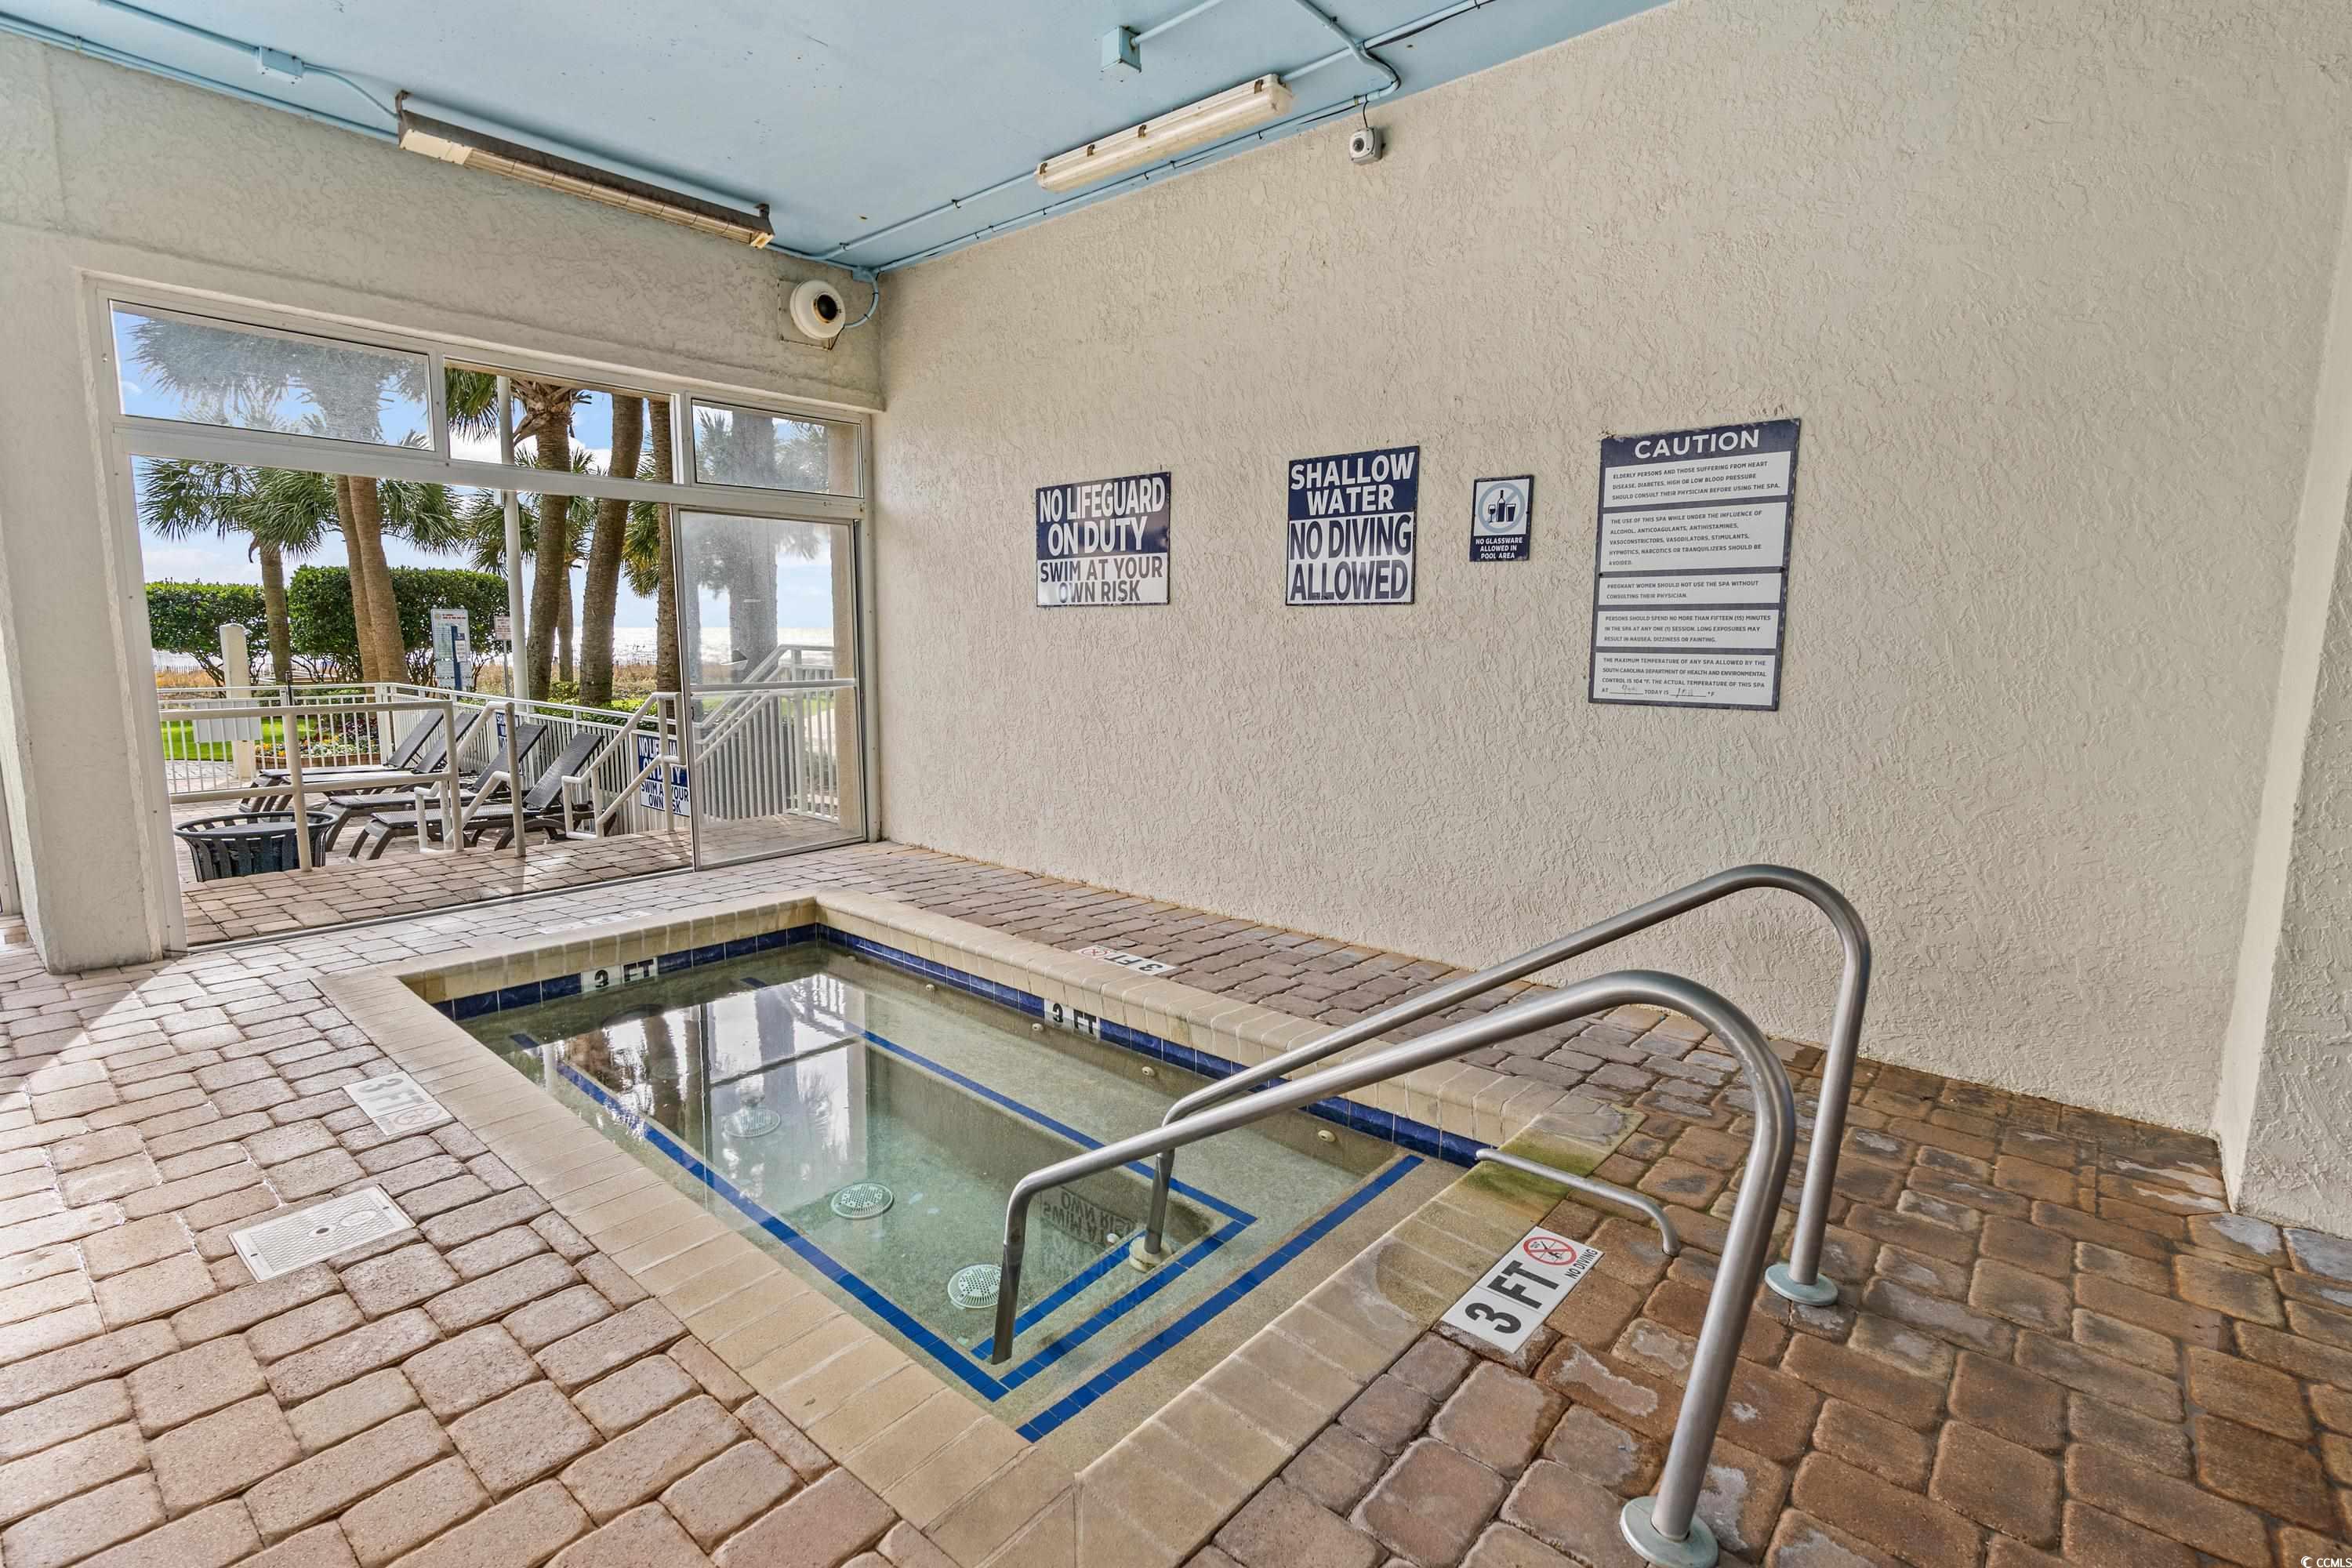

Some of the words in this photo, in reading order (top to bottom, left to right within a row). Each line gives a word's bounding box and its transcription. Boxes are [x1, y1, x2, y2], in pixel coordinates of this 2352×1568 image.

[1635, 429, 1759, 458] CAUTION
[1290, 452, 1415, 490] SHALLOW
[1040, 488, 1063, 523] NO
[1067, 477, 1165, 520] LIFEGUARD
[1306, 484, 1394, 516] WATER
[1048, 522, 1079, 556] ON
[1084, 516, 1147, 554] DUTY
[1290, 520, 1323, 560] NO
[1328, 514, 1411, 559] DIVING
[1040, 561, 1081, 583] SWIM
[1087, 559, 1109, 581] AT
[1114, 556, 1163, 579] YOUR
[1290, 560, 1408, 601] ALLOWED
[1059, 582, 1095, 603] OWN
[1101, 579, 1140, 602] RISK
[639, 737, 648, 757] NO
[649, 794, 664, 809] OWN
[594, 969, 609, 988] 3
[624, 959, 654, 982] FT
[1073, 1009, 1096, 1034] FT
[358, 1078, 404, 1093] 3
[1564, 1268, 1581, 1279] NO
[1573, 1249, 1598, 1270] DIVING
[1487, 1260, 1560, 1310] FT
[1465, 1303, 1521, 1334] 3
